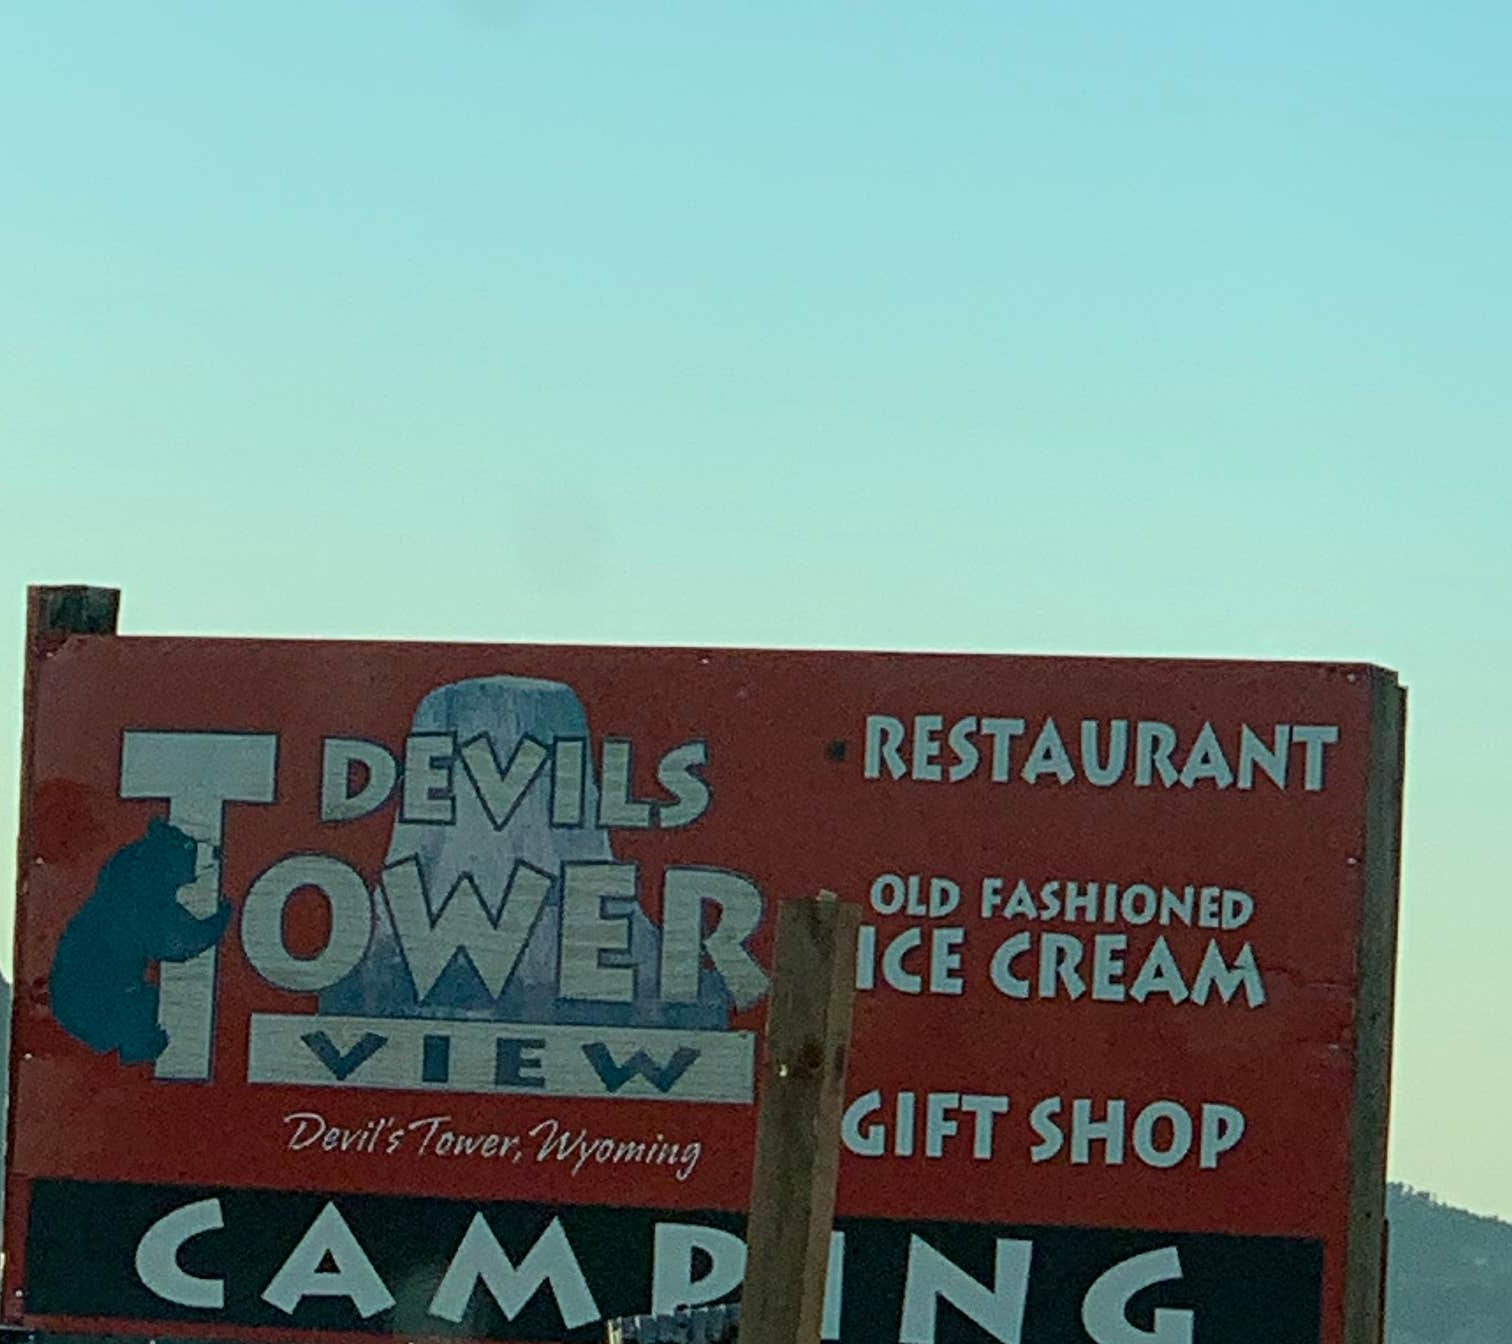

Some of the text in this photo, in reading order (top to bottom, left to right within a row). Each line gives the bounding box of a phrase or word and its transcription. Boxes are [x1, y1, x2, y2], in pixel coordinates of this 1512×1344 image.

[320, 732, 712, 830] DEVILS
[863, 714, 1339, 792] RESTAURANT
[870, 873, 1254, 930] OLD FASHIONED
[855, 925, 1266, 1008] ICE CREAM
[300, 1030, 701, 1093] VIEW
[284, 1112, 702, 1180] Devil's Tower, Wyoming
[840, 1090, 1245, 1170] GIFT SHOP
